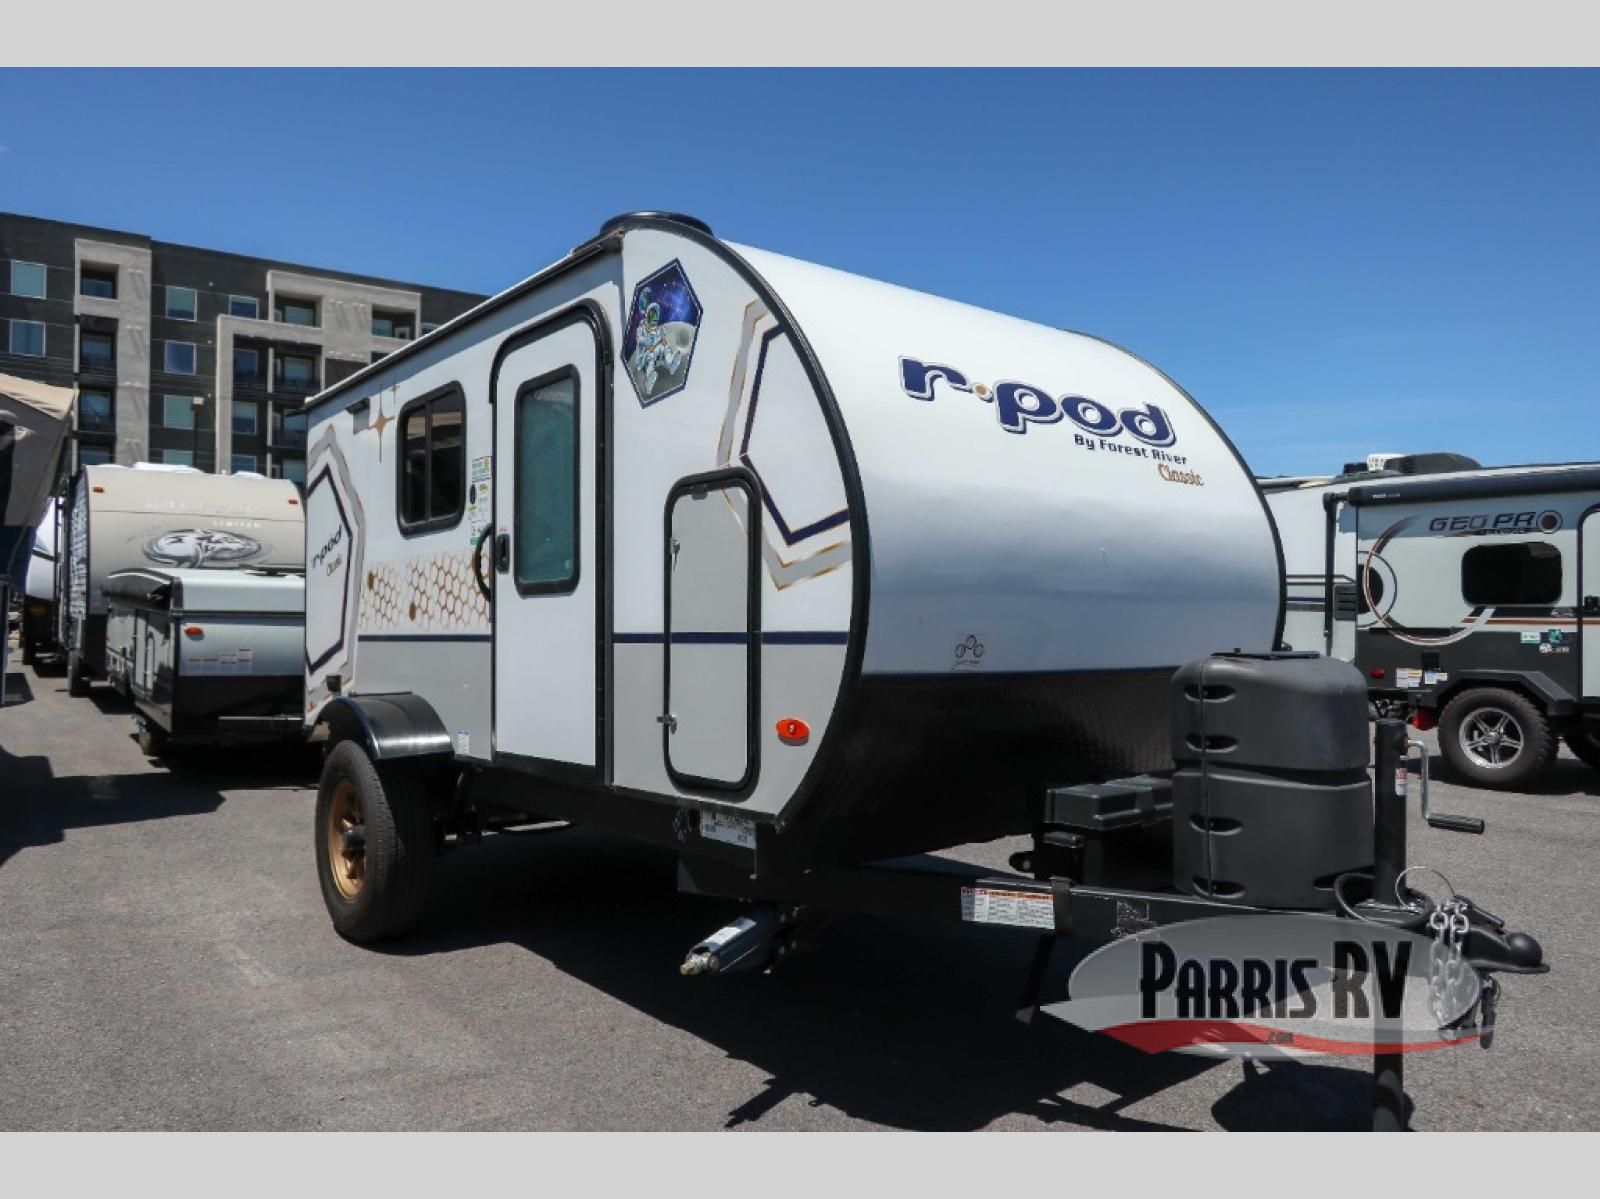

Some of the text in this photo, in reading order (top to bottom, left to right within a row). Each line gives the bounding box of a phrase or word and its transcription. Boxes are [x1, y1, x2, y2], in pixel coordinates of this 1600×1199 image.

[1074, 433, 1188, 465] By Forest River
[1157, 462, 1205, 486] Classic
[1429, 514, 1489, 532] GEO
